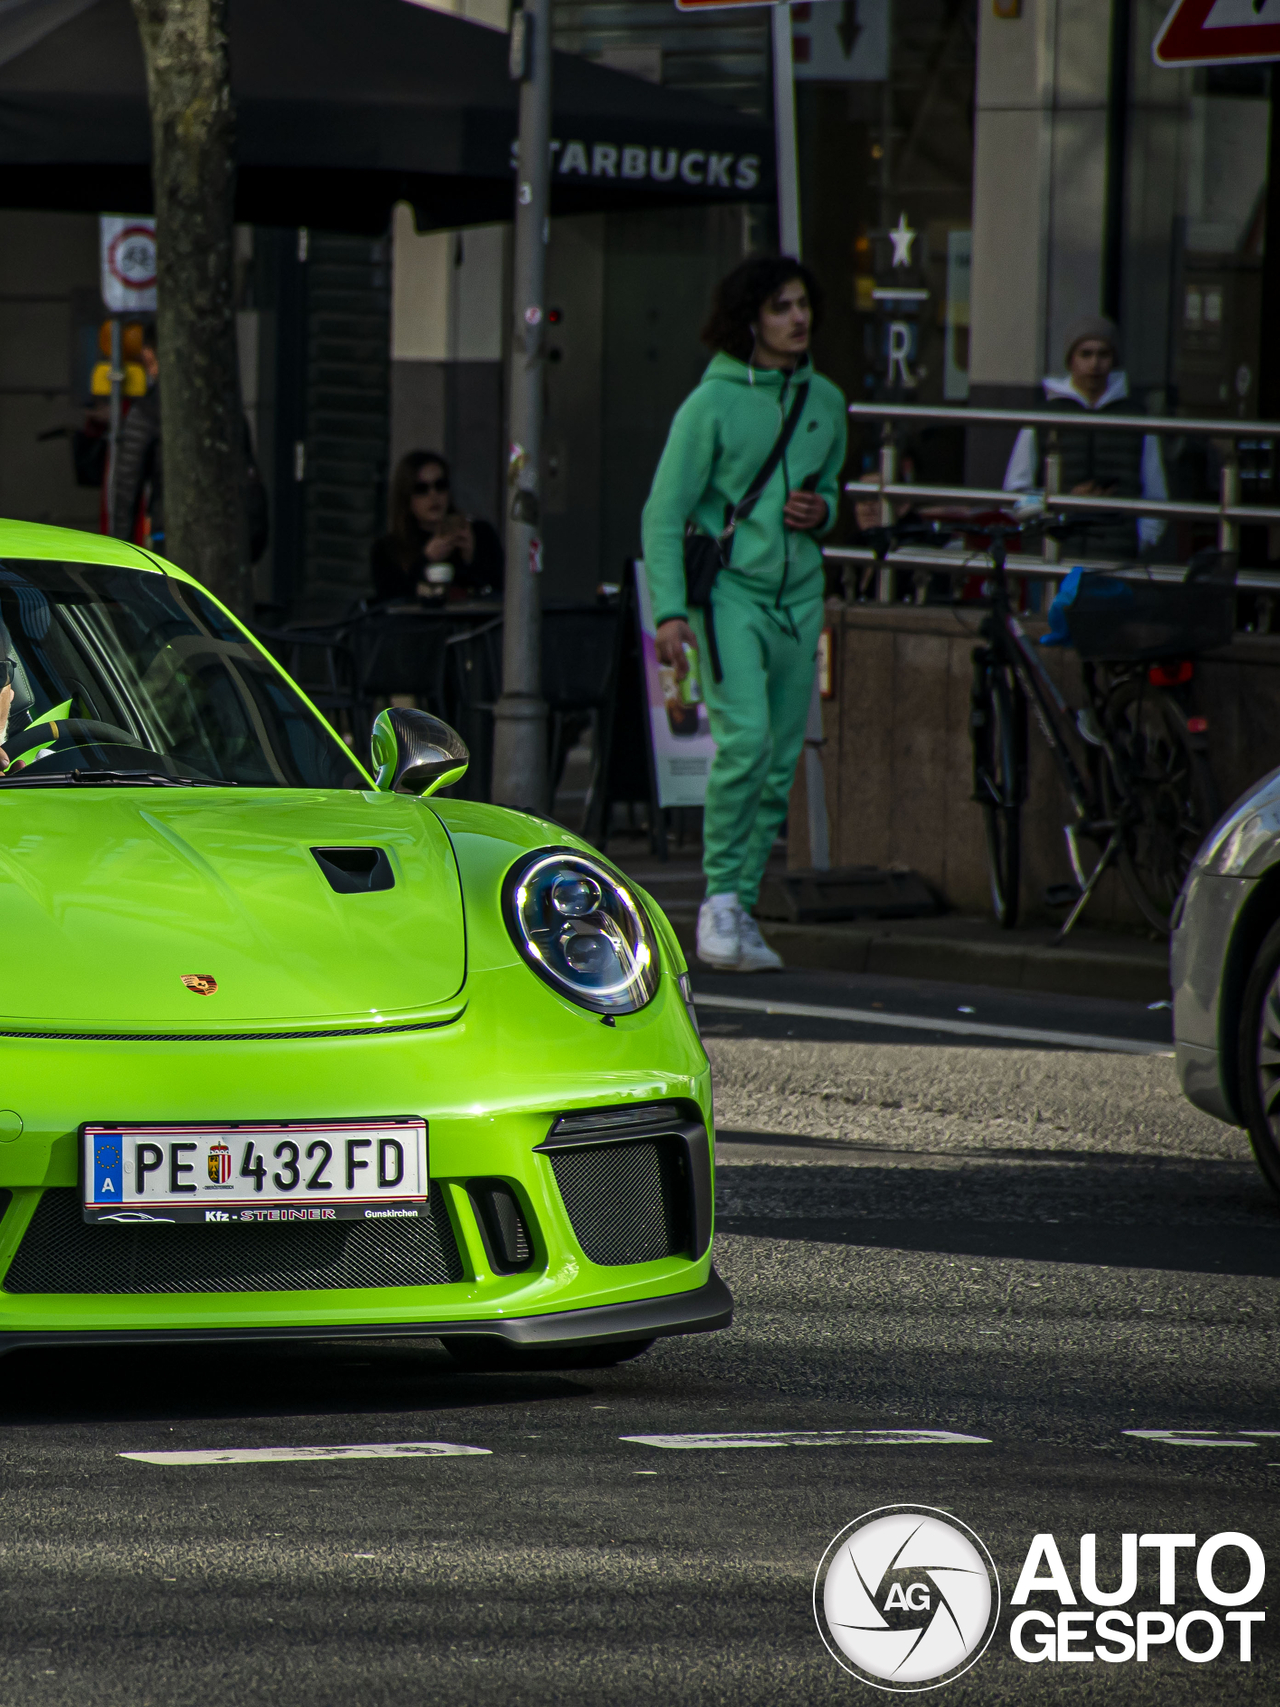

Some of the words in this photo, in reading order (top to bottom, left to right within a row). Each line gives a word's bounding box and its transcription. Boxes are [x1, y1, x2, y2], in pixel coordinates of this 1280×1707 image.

[135, 1141, 199, 1195] PE
[238, 1139, 334, 1193] 432
[345, 1137, 404, 1191] FD
[101, 1177, 115, 1193] A
[204, 1211, 230, 1222] Kfz
[239, 1208, 337, 1222] STEINER
[364, 1209, 418, 1218] Gunskirchen
